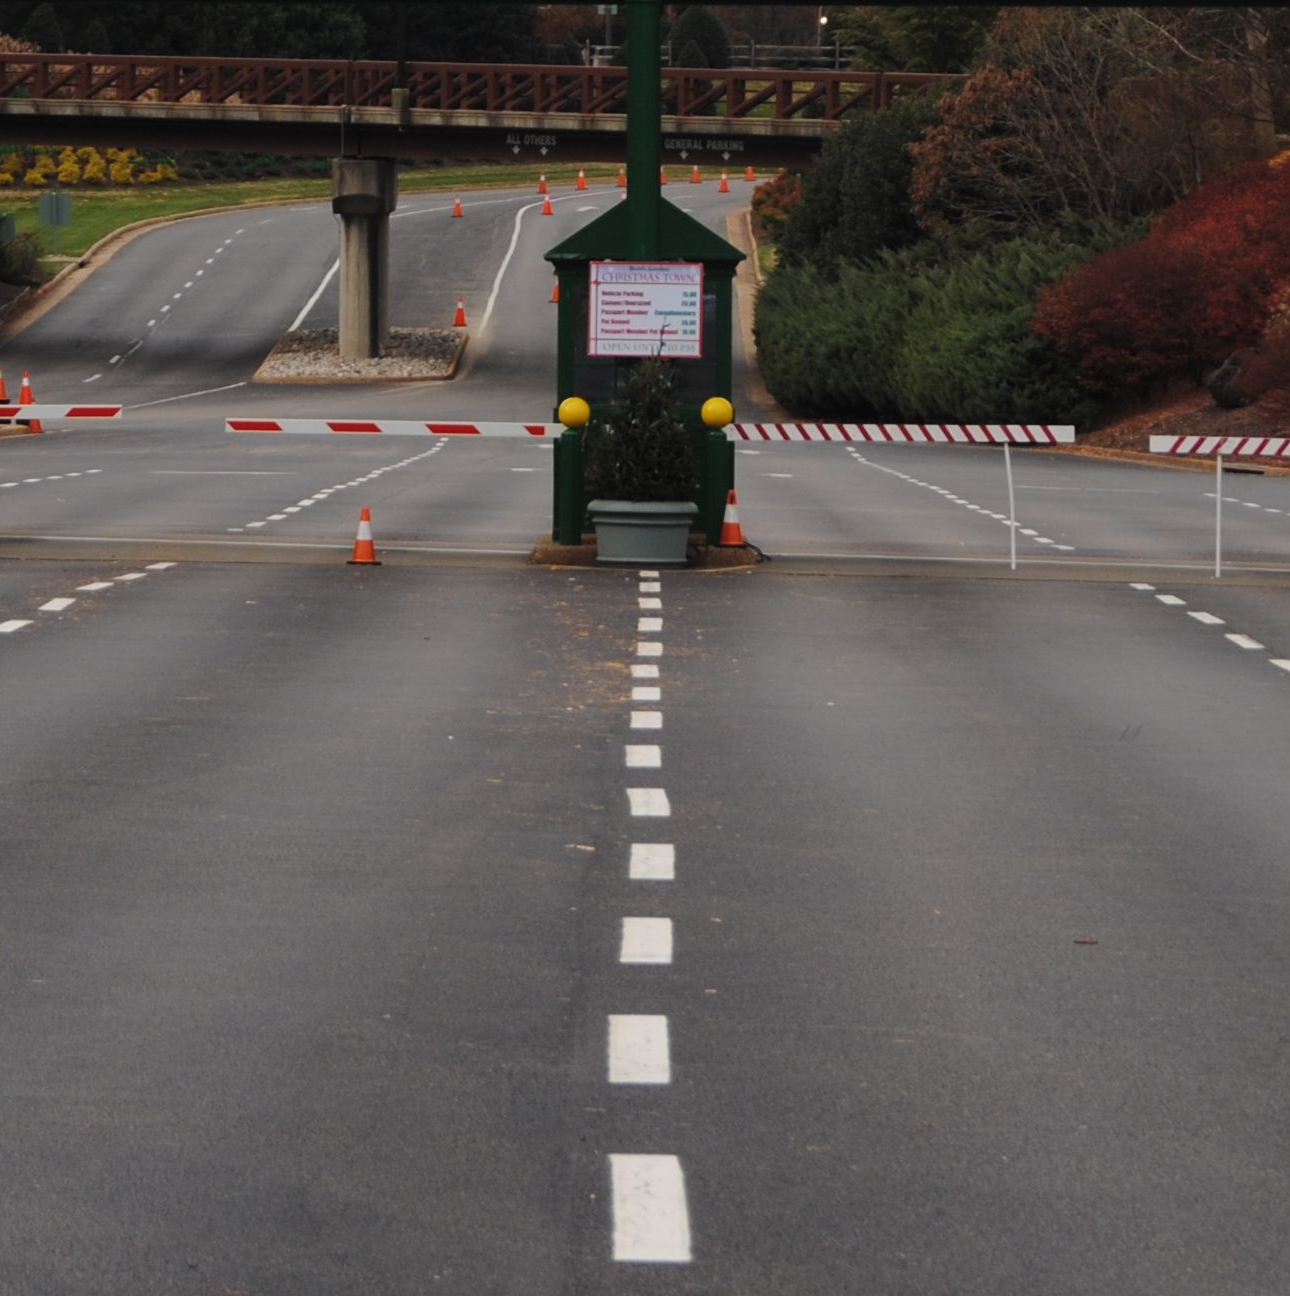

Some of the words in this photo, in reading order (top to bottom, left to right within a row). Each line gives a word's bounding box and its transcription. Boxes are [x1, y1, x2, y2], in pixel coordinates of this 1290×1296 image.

[506, 133, 520, 144] ALL
[524, 135, 557, 145] OTHERS
[602, 273, 660, 281] CHRISTMAS
[663, 273, 695, 282] TOWN
[603, 343, 630, 351] OPEN
